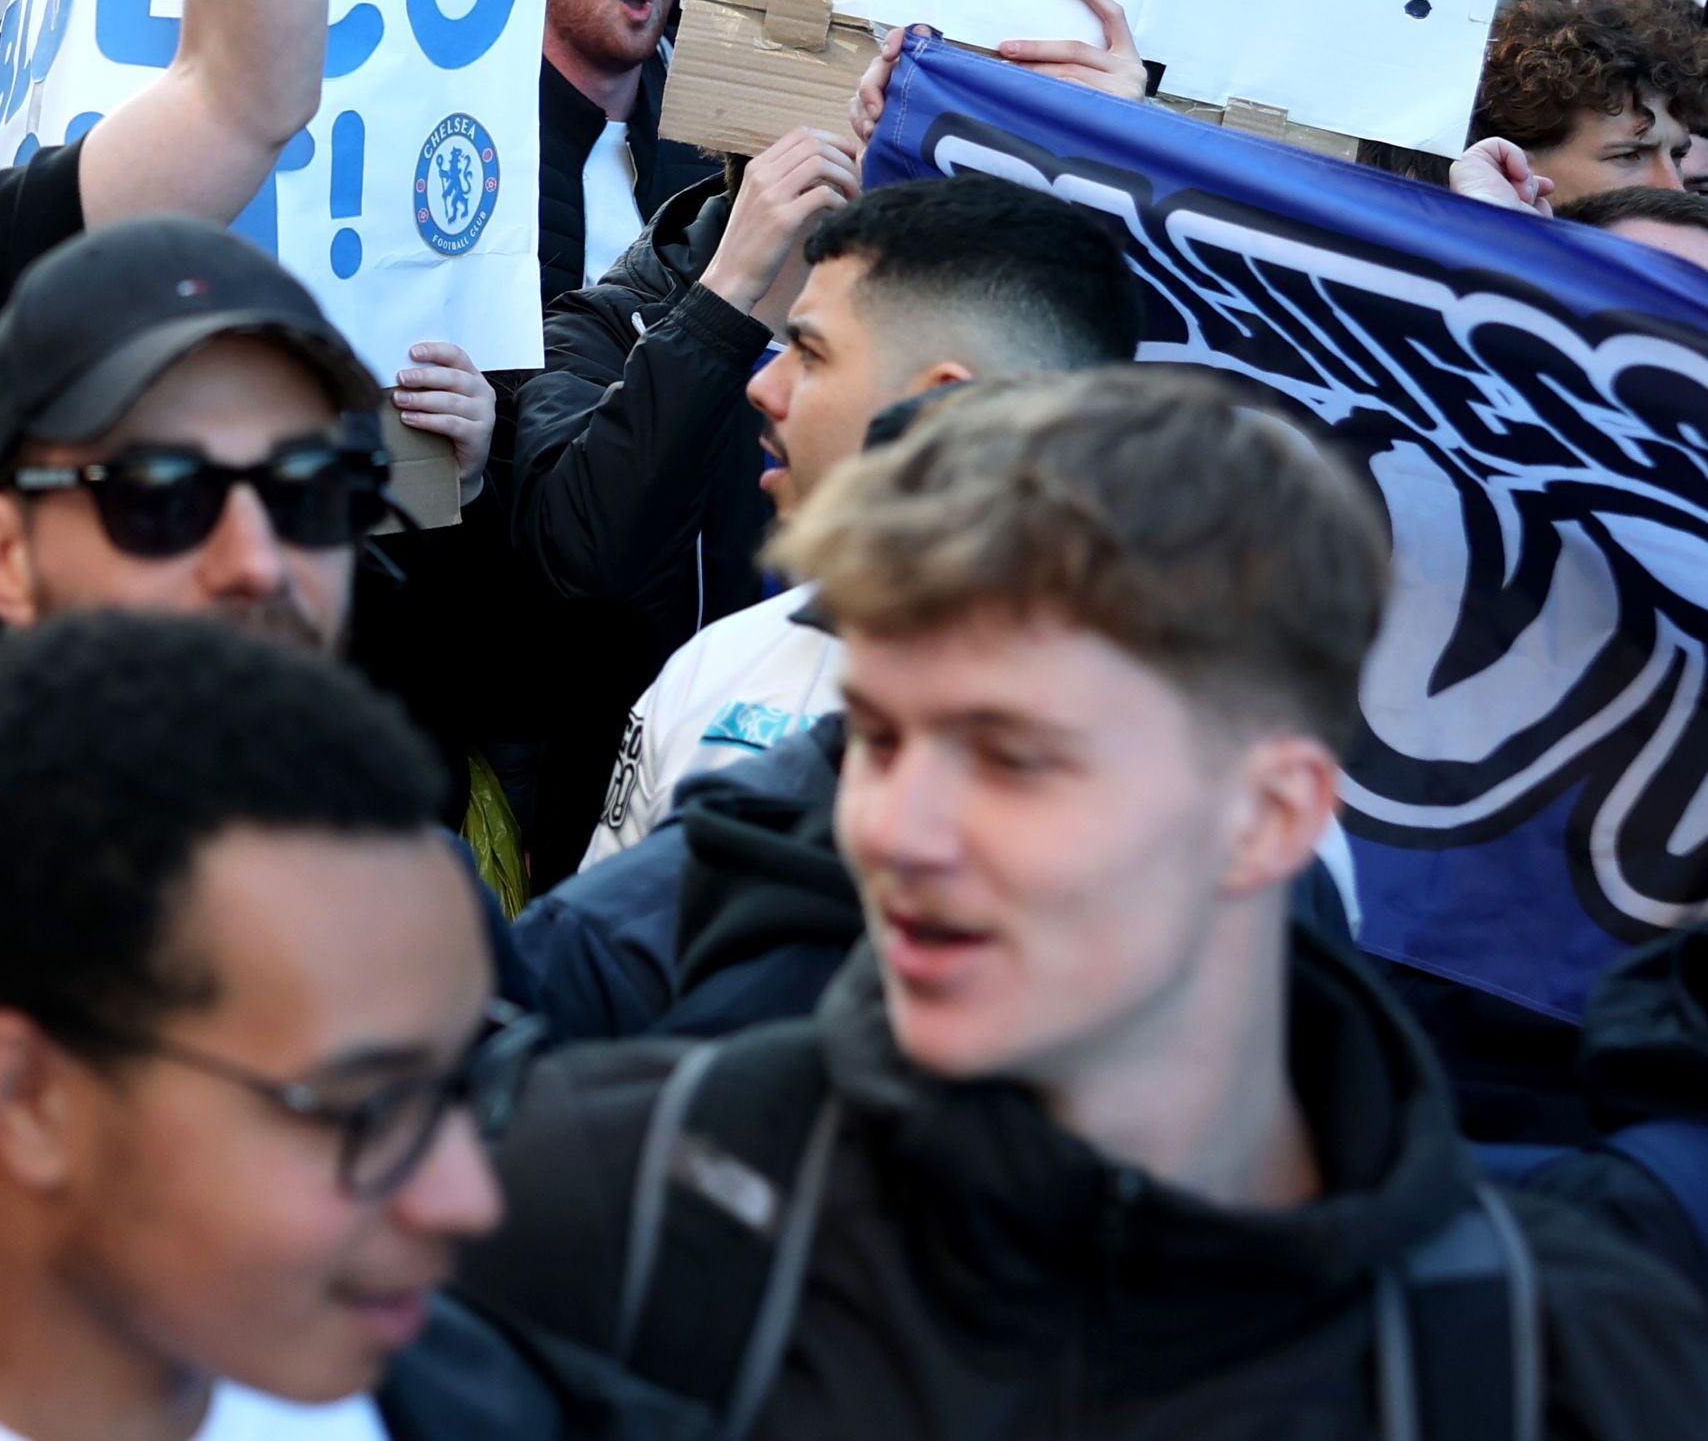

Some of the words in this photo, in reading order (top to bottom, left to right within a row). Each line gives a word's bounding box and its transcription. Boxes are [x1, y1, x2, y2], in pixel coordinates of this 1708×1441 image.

[423, 116, 477, 160] CHELSEA
[432, 234, 470, 252] FOOTBALL
[470, 210, 488, 238] CLUB
